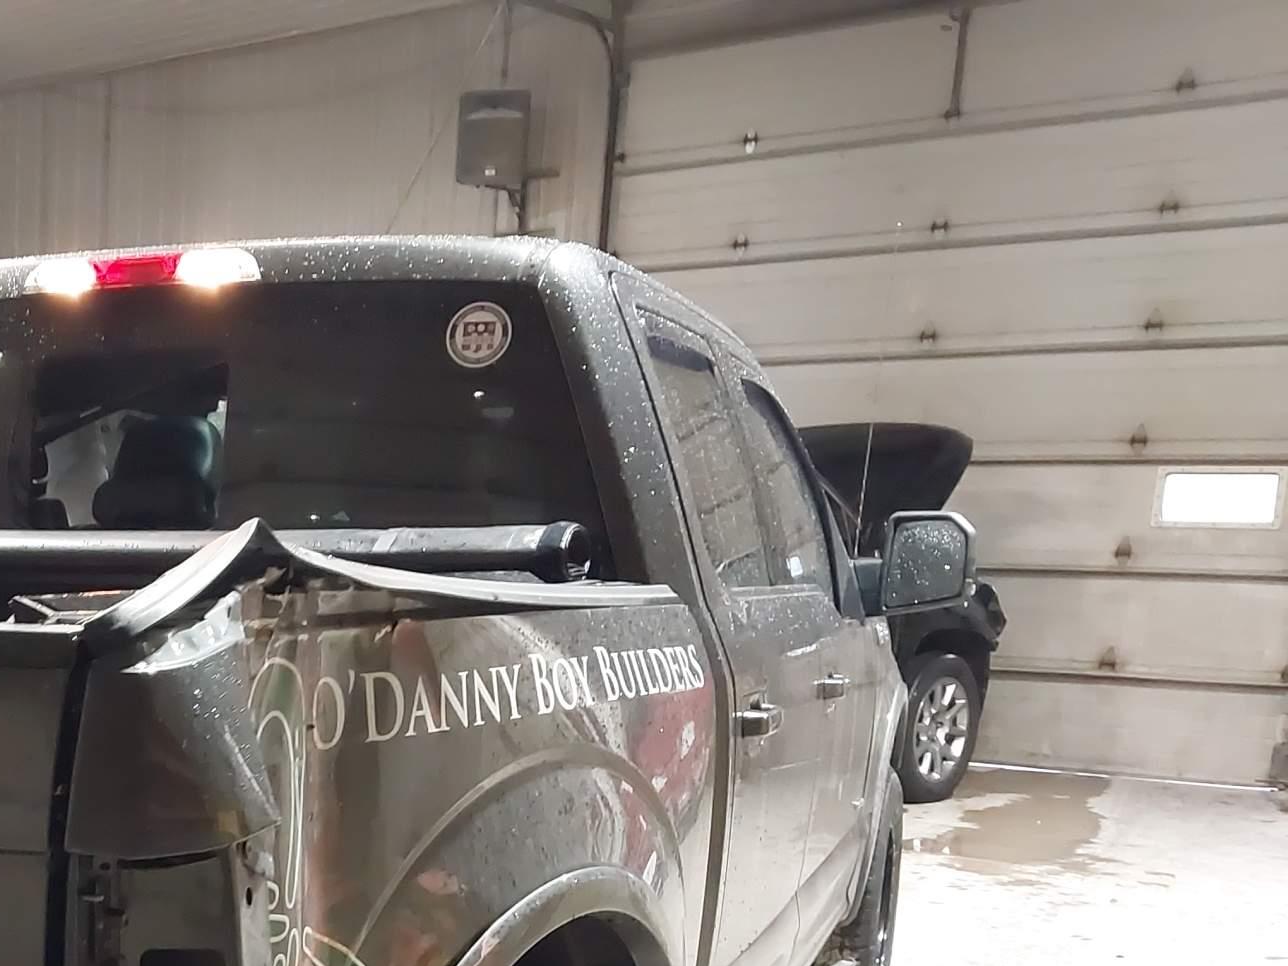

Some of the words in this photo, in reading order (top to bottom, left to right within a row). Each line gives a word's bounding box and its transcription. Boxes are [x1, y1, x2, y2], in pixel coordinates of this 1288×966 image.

[312, 663, 521, 751] O'DANNY
[528, 652, 598, 715] BOY
[593, 643, 705, 702] BUILDERS
